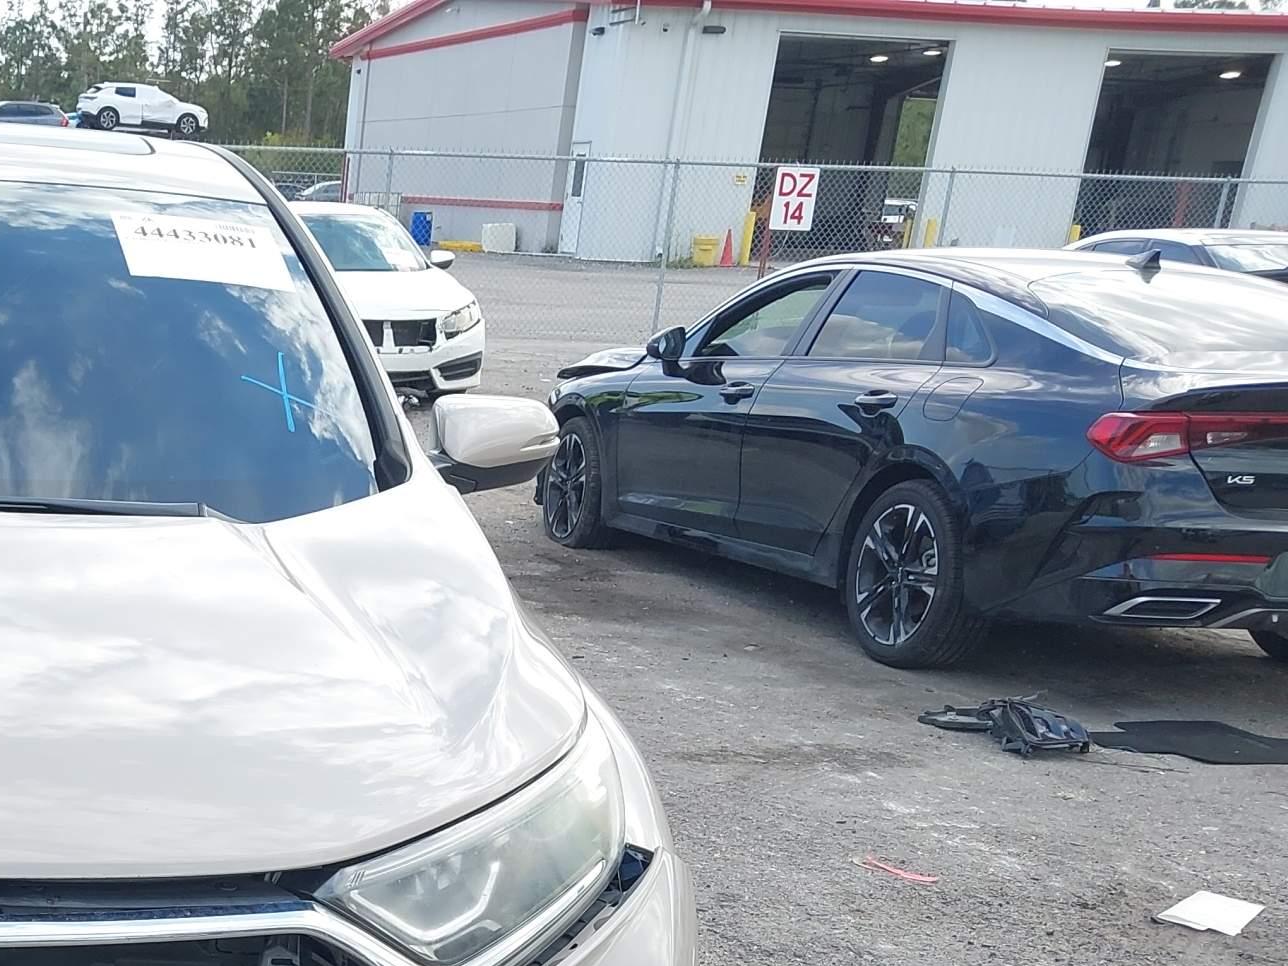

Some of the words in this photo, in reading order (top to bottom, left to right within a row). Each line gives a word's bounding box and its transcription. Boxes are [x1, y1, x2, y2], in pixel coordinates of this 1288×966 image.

[778, 172, 816, 198] DZ
[782, 201, 804, 225] 14
[134, 226, 256, 249] 44433081
